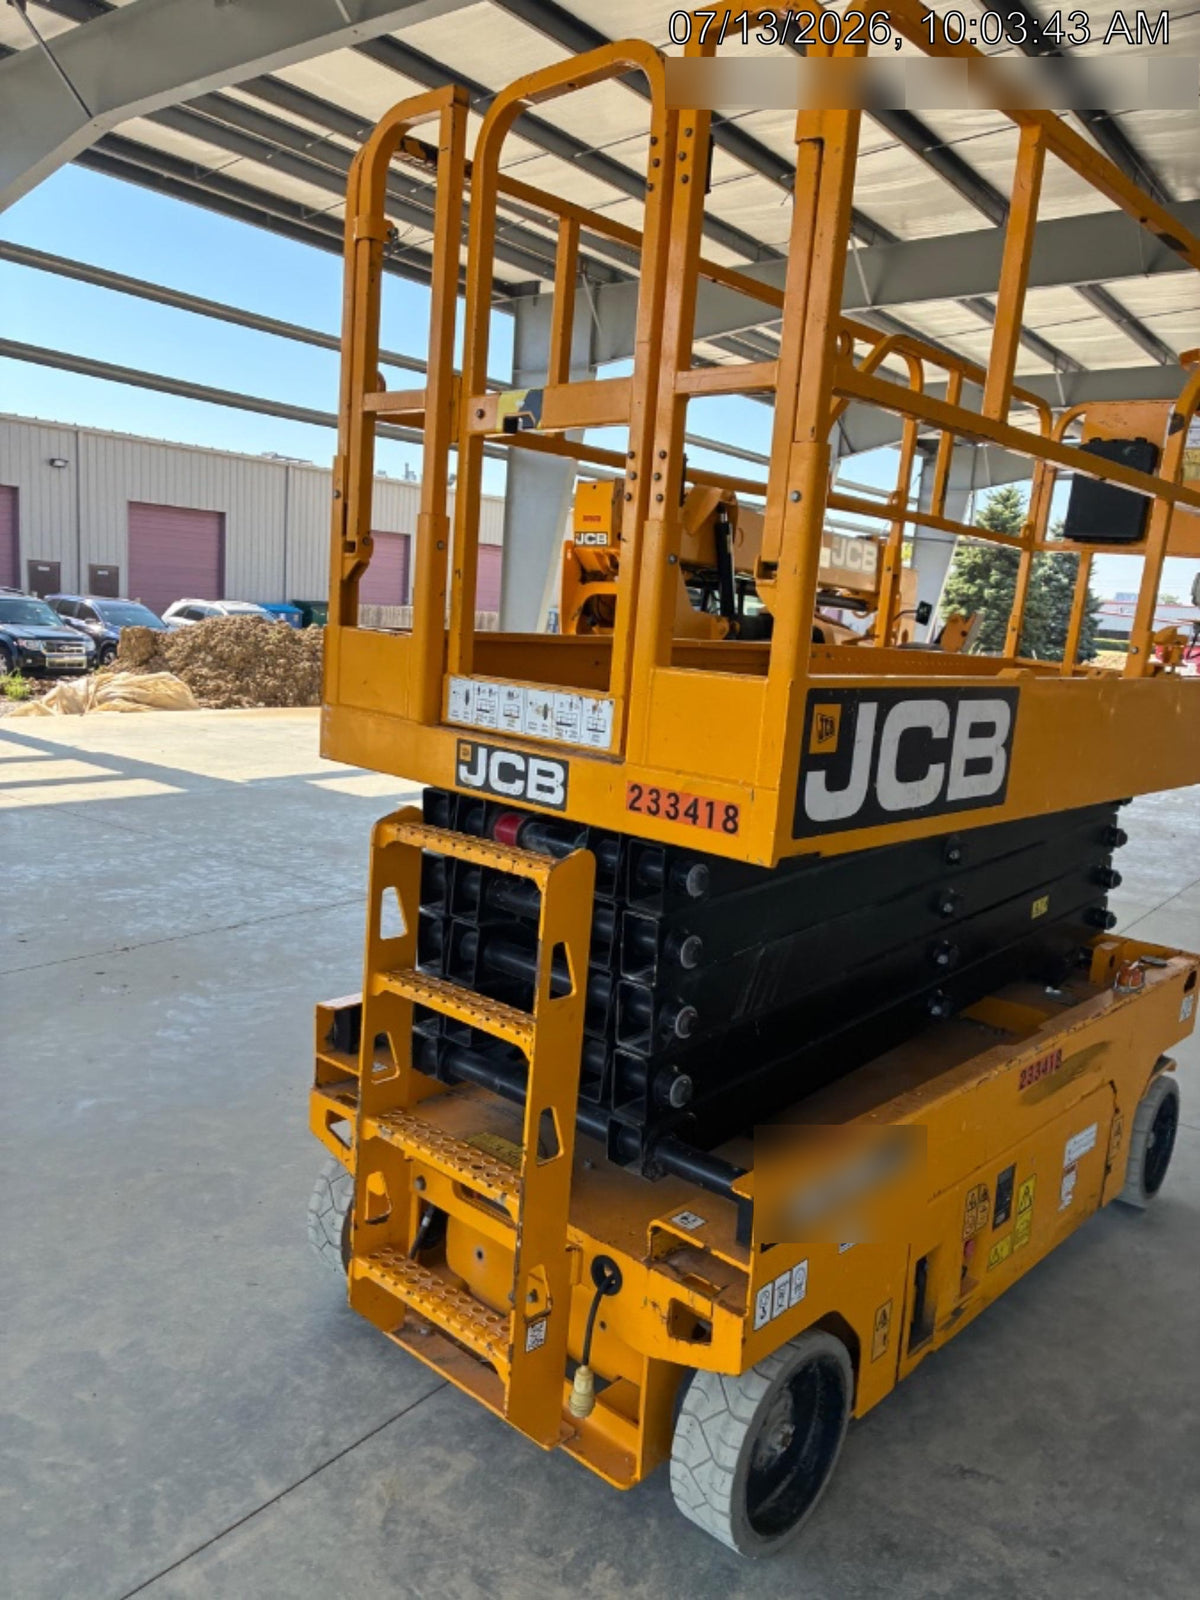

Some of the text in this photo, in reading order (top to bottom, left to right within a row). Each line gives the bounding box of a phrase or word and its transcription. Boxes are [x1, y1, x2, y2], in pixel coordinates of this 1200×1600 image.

[575, 532, 608, 545] JCB
[831, 537, 877, 573] JCB
[458, 746, 566, 806] JCB
[804, 699, 1011, 822] JCB
[628, 783, 740, 835] 233418
